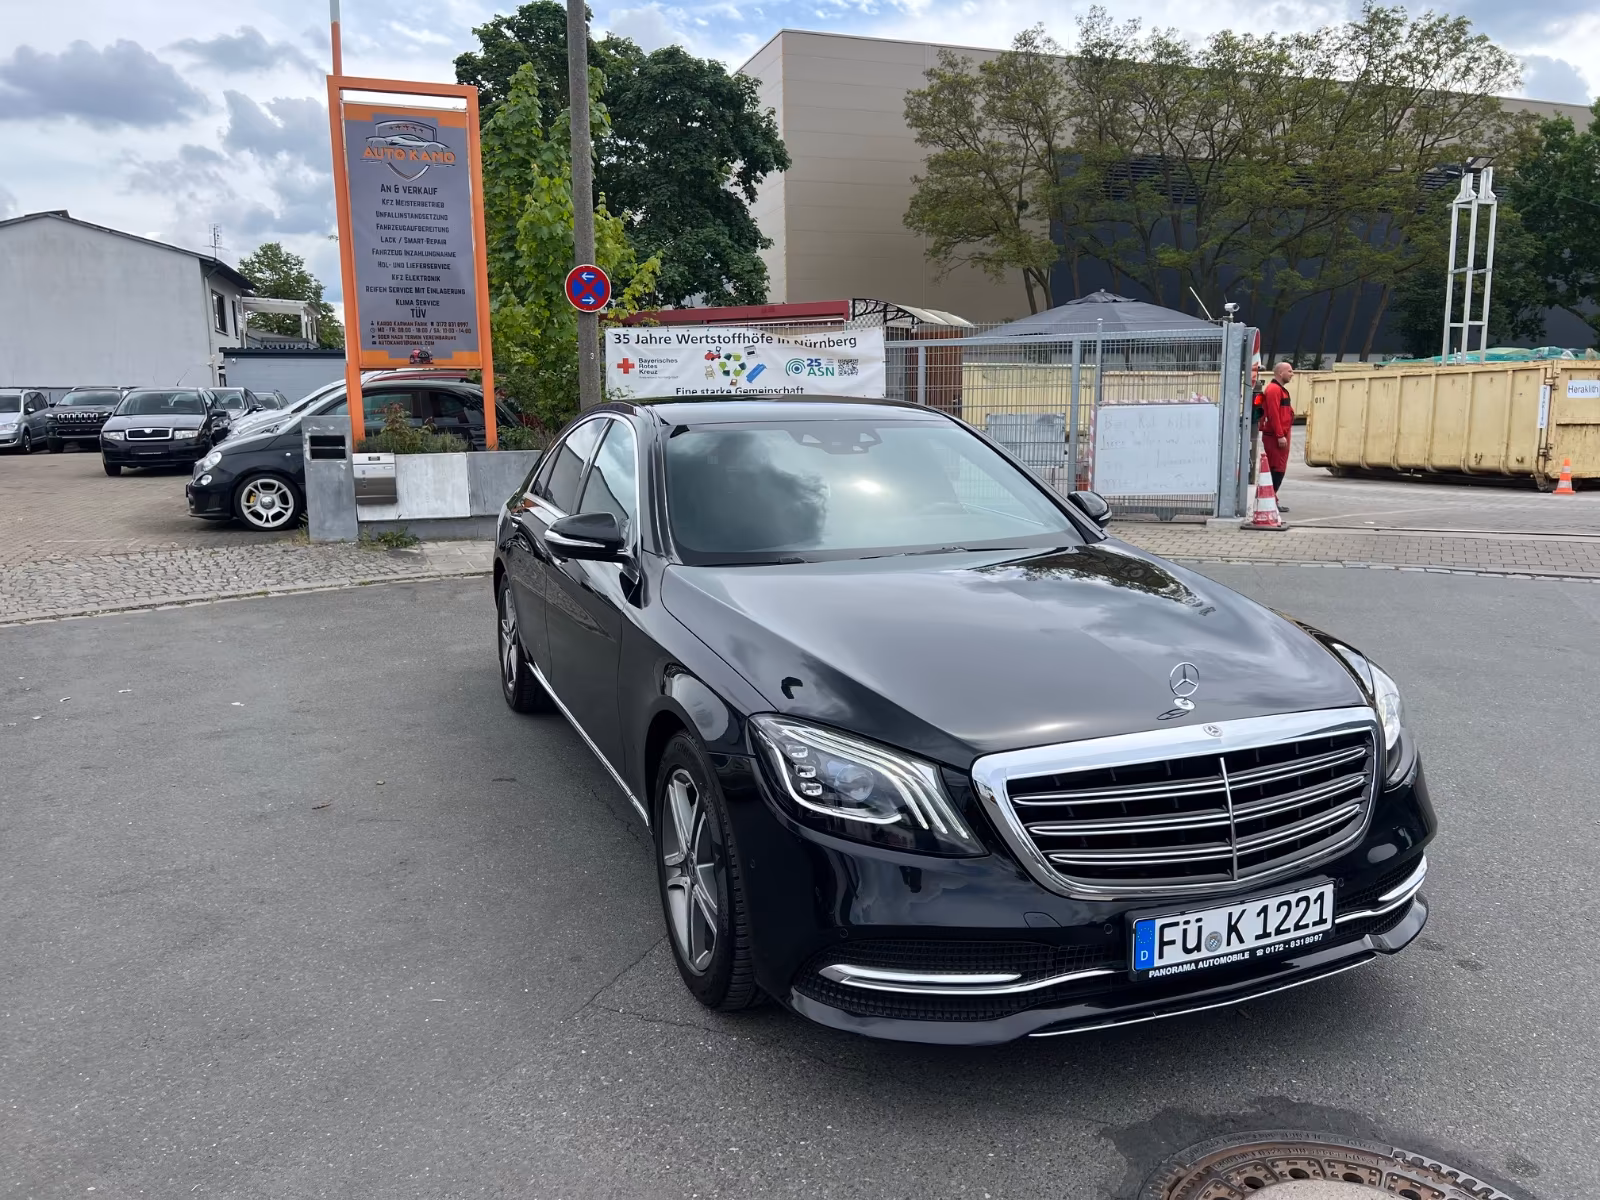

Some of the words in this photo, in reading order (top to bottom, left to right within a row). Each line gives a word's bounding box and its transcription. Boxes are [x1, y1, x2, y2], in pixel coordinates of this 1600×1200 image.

[363, 146, 406, 160] AUTO
[394, 184, 400, 194] &
[403, 186, 438, 196] VERKAUF
[395, 199, 445, 208] MEISTERBETRIEB
[375, 211, 448, 220] UNFALLINSTANDSETZUNG
[376, 223, 449, 233] FAHRZEUGAUFBEREITUNG
[380, 236, 397, 244] LACK
[371, 249, 403, 257] FAHRZEUG
[406, 262, 451, 271] LIEFERSERVICE
[405, 274, 441, 282] ELEKTRONIK
[388, 286, 414, 294] SERVICE
[426, 287, 466, 295] EINLAGERUNG
[395, 298, 414, 306] KLIMA
[415, 299, 440, 307] SERVICE
[410, 306, 427, 318] TÜV
[613, 333, 631, 345] 35
[634, 333, 672, 345] Jahre
[676, 332, 774, 345] Wertstoffhöfe
[794, 336, 857, 349] Nürnberg
[638, 357, 678, 365] Bayerisches
[806, 358, 822, 367] 25
[807, 367, 835, 377] ASN
[675, 387, 698, 395] Eine
[700, 387, 732, 395] starke
[735, 386, 804, 395] Gemeinschaft
[1158, 917, 1203, 960] FÜ
[1226, 908, 1247, 947] K
[1254, 891, 1328, 941] 1221
[1140, 950, 1148, 961] D
[1148, 962, 1196, 978] PANORAMA
[1197, 951, 1250, 969] AUTOMOBILE
[1265, 943, 1284, 954] 0172
[1290, 933, 1323, 948] 8318997
